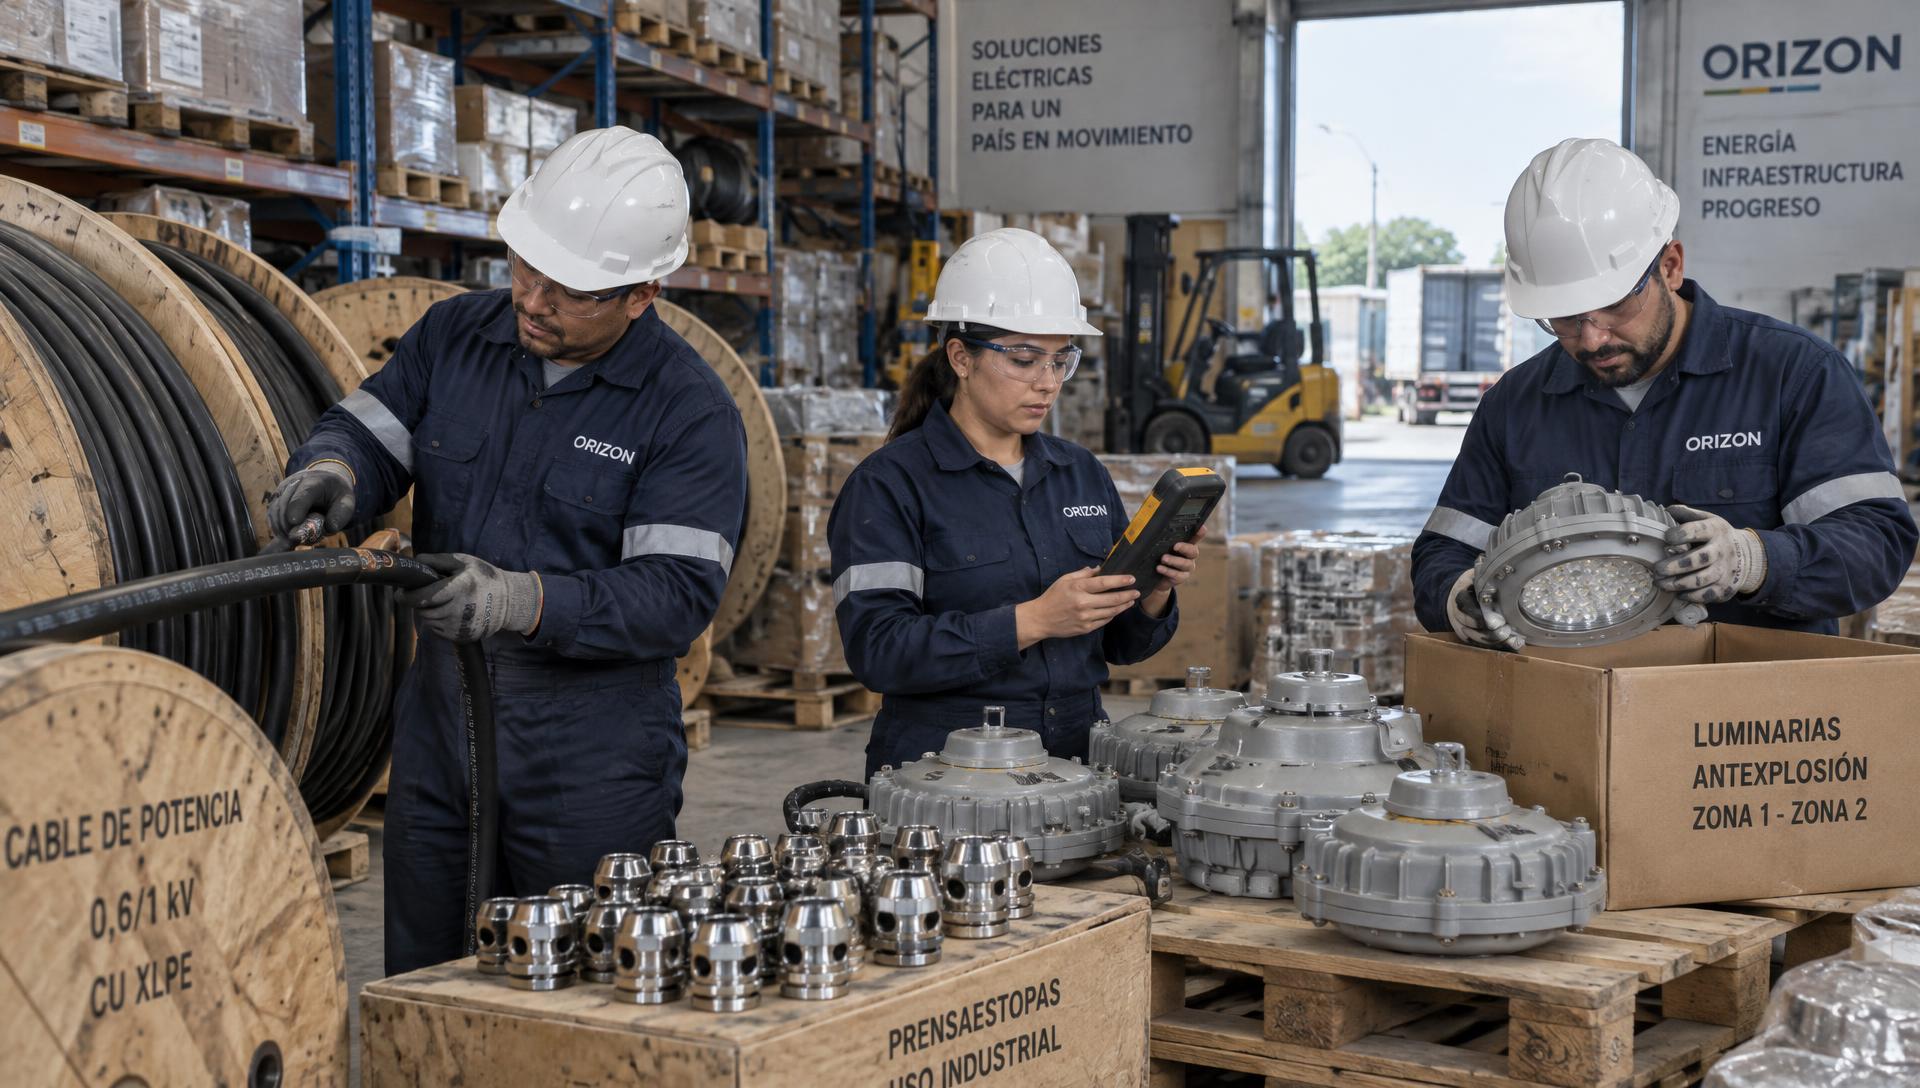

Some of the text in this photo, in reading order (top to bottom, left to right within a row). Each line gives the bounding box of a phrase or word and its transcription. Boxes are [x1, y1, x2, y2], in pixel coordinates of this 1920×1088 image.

[972, 34, 1102, 60] SOLUCIONES
[1703, 33, 1902, 80] ORIZON
[972, 66, 1093, 91] ELÉCTRICAS
[972, 99, 1061, 121] PARA UN
[972, 124, 1193, 151] PAÍS EN MOVIMIENTO
[1703, 129, 1797, 156] ENERGÍA
[1703, 162, 1904, 188] INFRAESTRUCTURA
[1702, 197, 1821, 219] PROGRESO
[573, 435, 636, 465] ORIZON
[1685, 431, 1762, 452] ORIZON
[1062, 504, 1108, 518] ORIZON
[1694, 716, 1842, 748] LUMINARIAS
[1692, 752, 1868, 790] ANTEXPLOSIÓN
[1692, 803, 1753, 830] ZONA
[1760, 802, 1769, 827] 1
[1791, 798, 1849, 825] ZONA
[1855, 797, 1868, 821] 2
[5, 789, 243, 870] CABLE DE POTENCIA
[91, 877, 194, 943] 0,6/1 kV
[90, 951, 193, 1019] CU XLPE
[889, 978, 1061, 1060] PRENSAESTOPAS
[942, 1024, 1062, 1088] INDUSTRIAL
